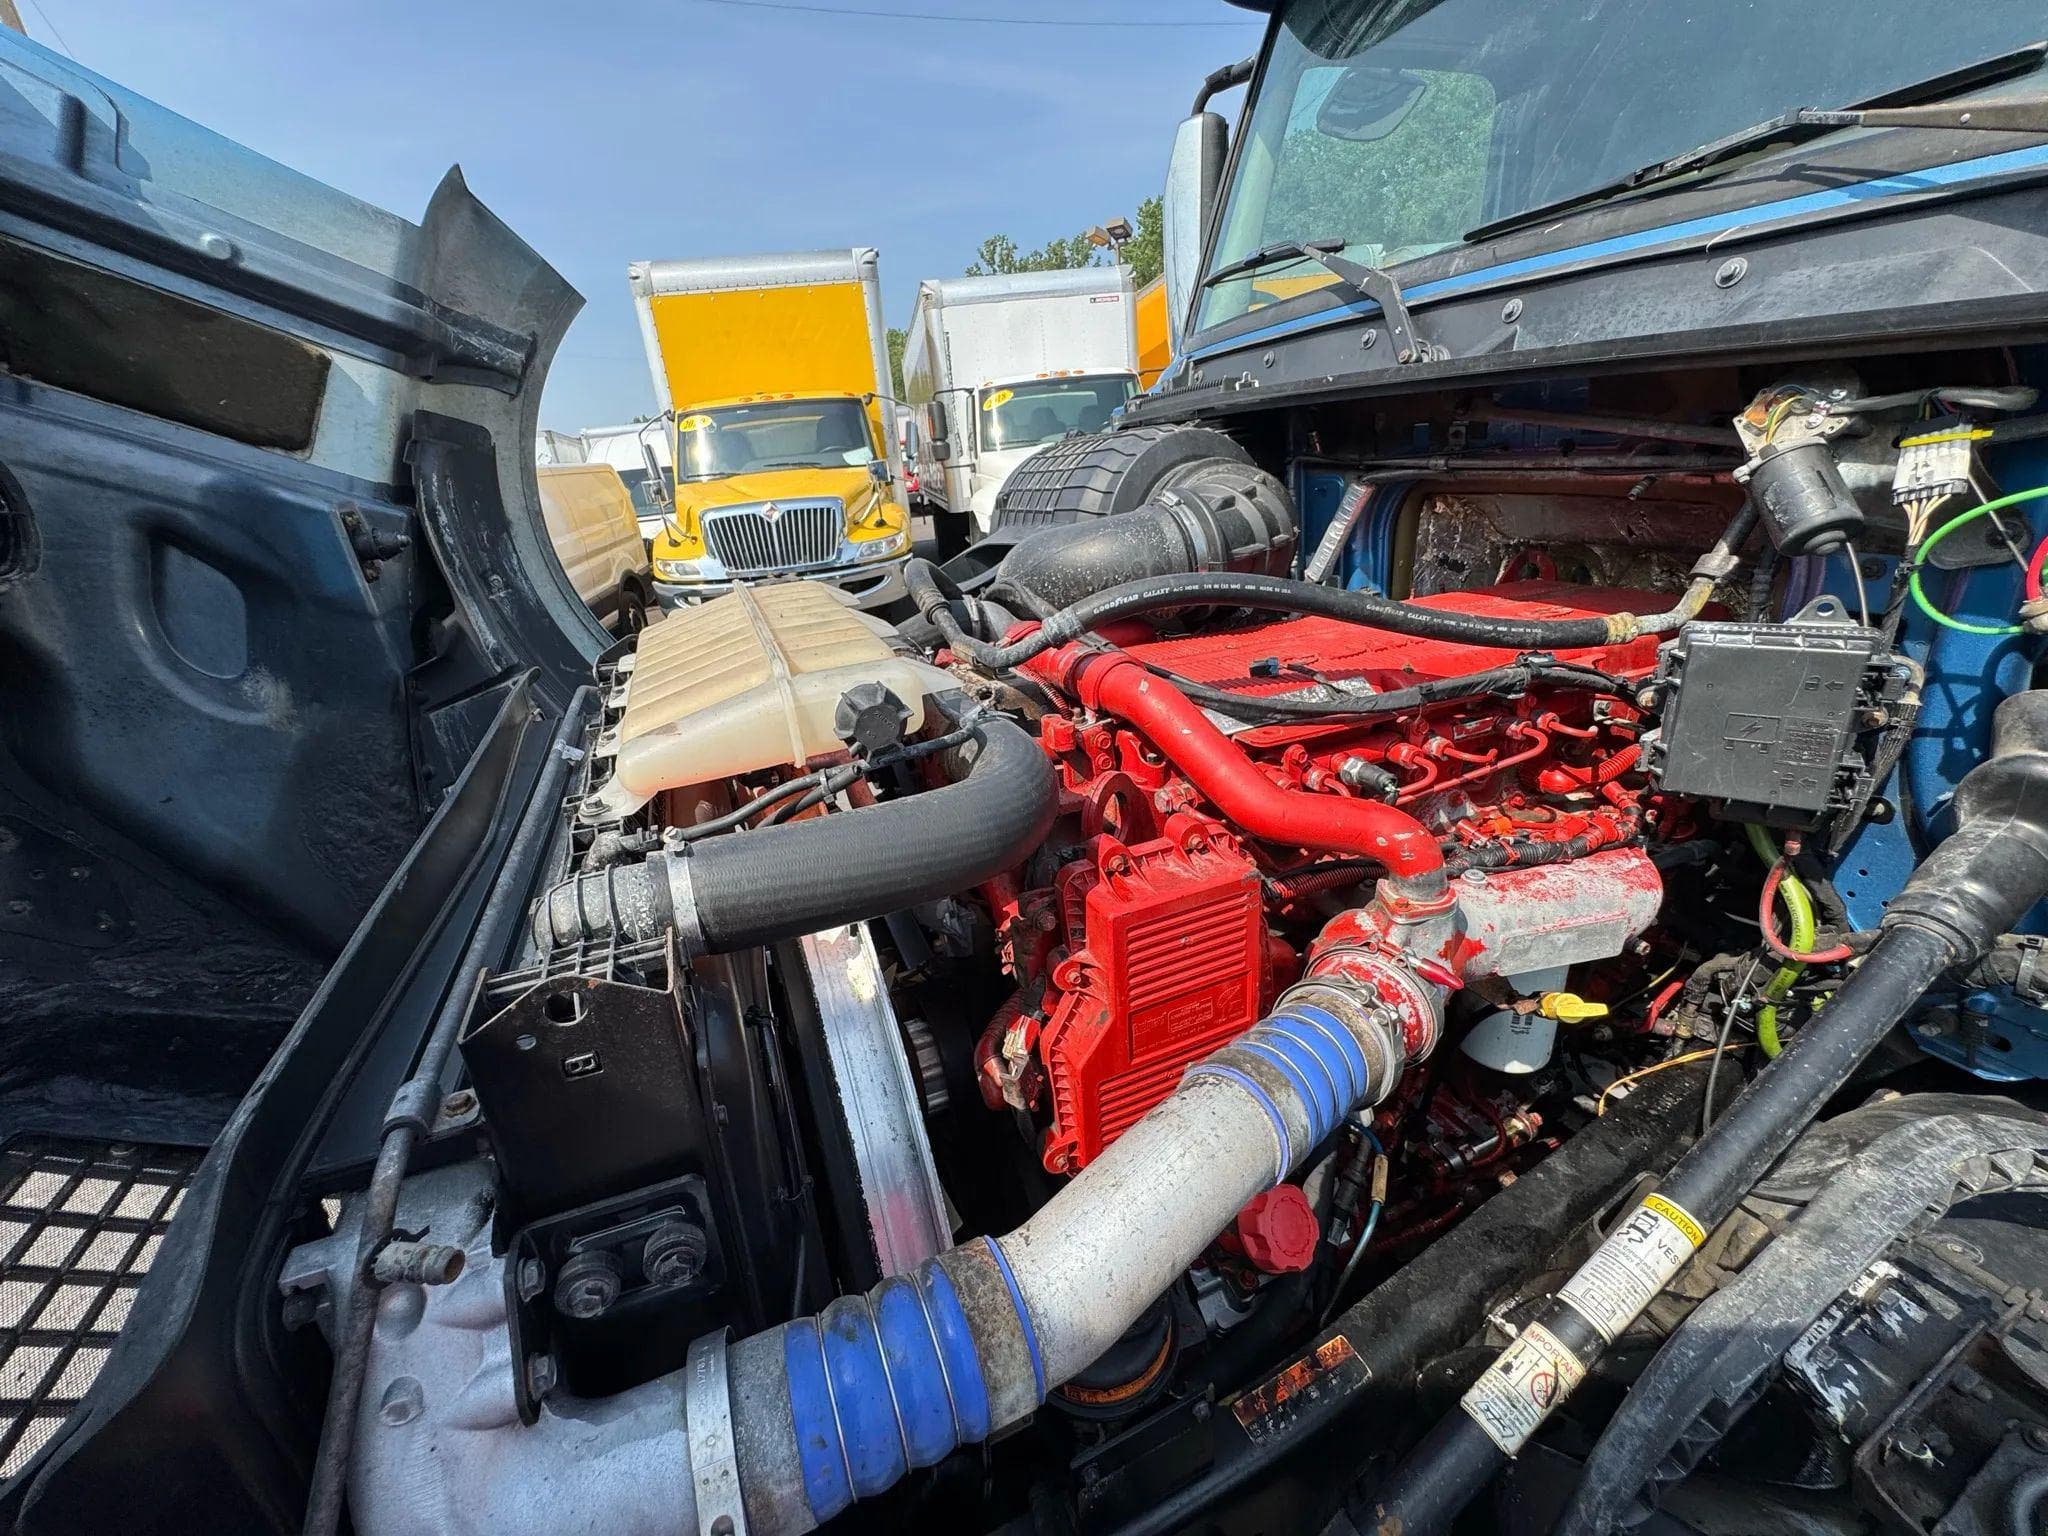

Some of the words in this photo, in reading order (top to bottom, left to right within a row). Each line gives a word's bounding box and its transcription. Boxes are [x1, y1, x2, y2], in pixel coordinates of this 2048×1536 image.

[1093, 594, 1139, 614] GOODYEAR
[1143, 587, 1170, 598] GALAXY
[1407, 612, 1431, 621] GALAXY
[1654, 1201, 1698, 1241] CAUTION
